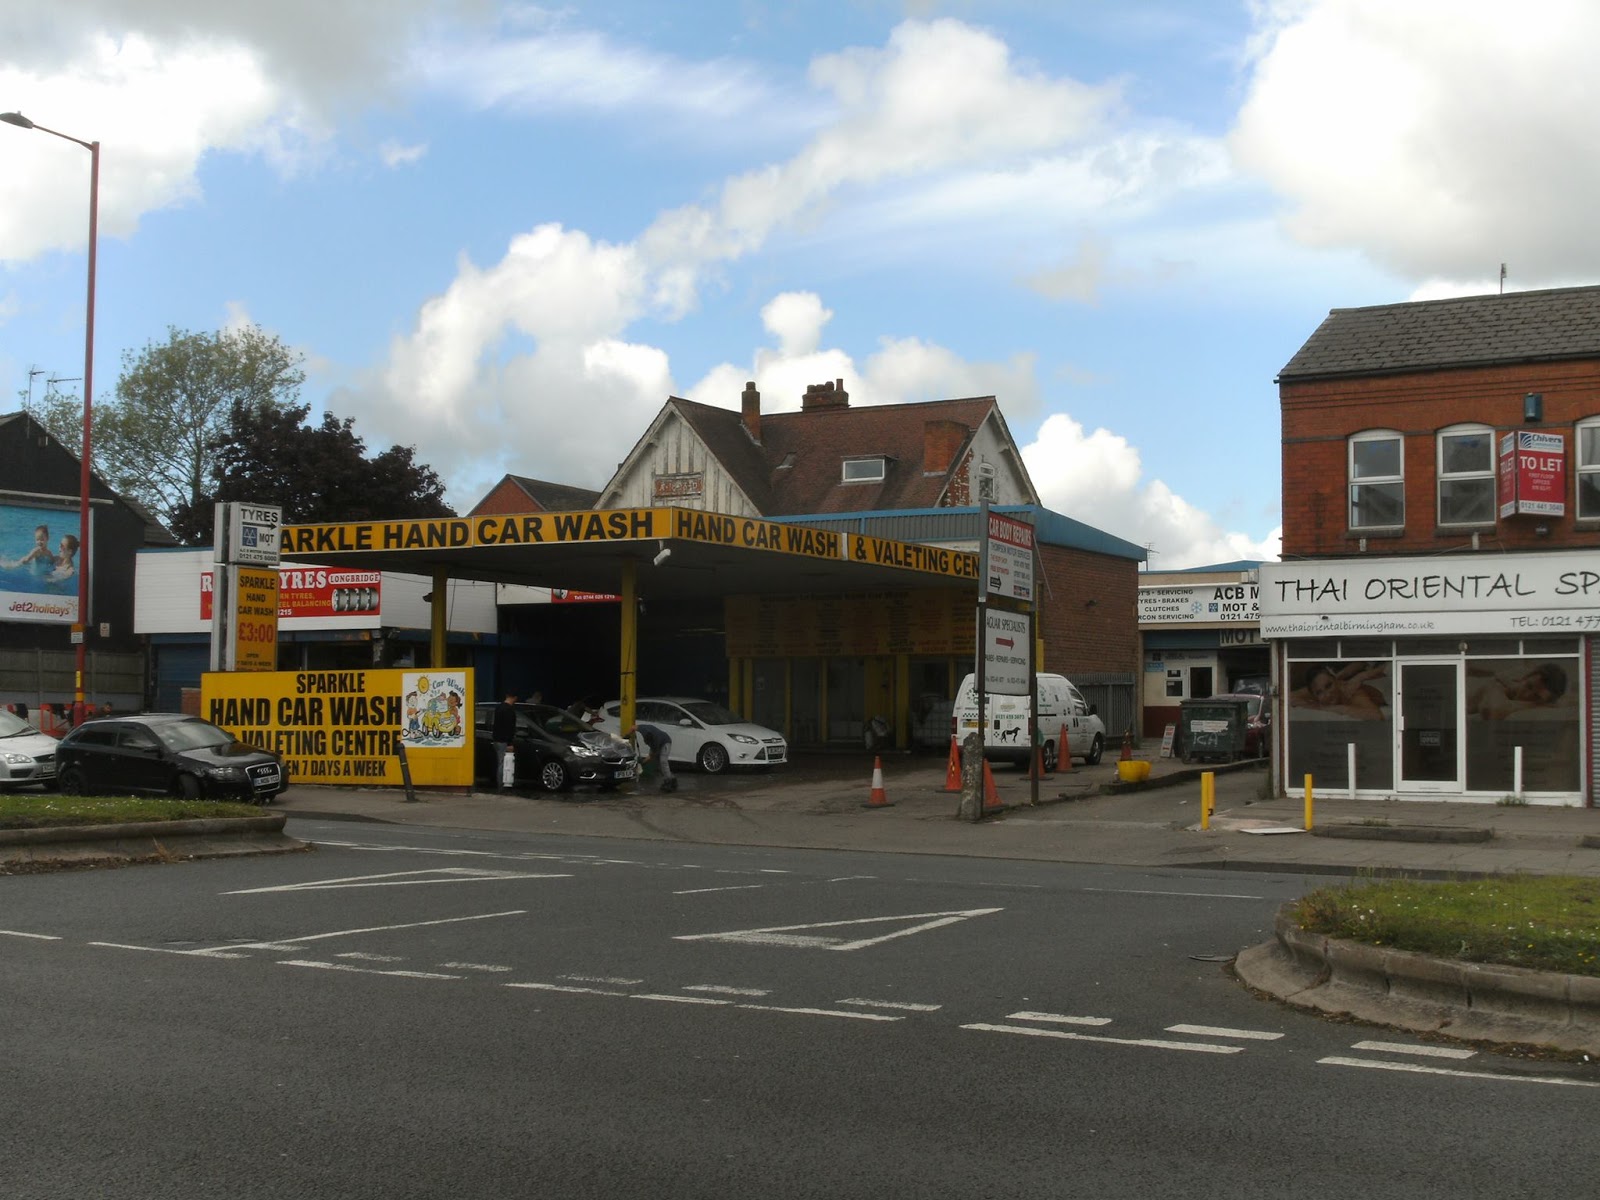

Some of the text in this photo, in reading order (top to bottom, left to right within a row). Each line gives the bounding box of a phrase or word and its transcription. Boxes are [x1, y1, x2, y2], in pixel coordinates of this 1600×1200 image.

[1520, 456, 1562, 472] TO LET
[241, 508, 279, 523] TYRES
[259, 533, 275, 545] MOT
[280, 512, 654, 552] ARKLE HAND CAR WASH
[989, 517, 1032, 547] CAR BODY REPAIRS
[678, 511, 980, 578] HAND CAR WASH & VALETING CEN
[239, 576, 276, 590] SPARKLE
[279, 571, 327, 589] YRES
[331, 573, 379, 583] LONGBRIDGE
[1274, 571, 1600, 603] THAI ORIENTAL SP
[246, 593, 266, 602] HAND
[1214, 587, 1245, 600] ACB
[9, 602, 70, 617] jet2holidays
[238, 606, 274, 616] CAR WASH
[292, 600, 331, 608] BALANCING
[1222, 603, 1260, 612] MOT &
[1002, 618, 1026, 634] SPECIALISTS
[1265, 621, 1435, 633] www.thaiorientalbirmingham.co.uk
[1510, 616, 1539, 627] TEL:
[1542, 616, 1571, 626] 0121
[1221, 630, 1255, 644] MOT
[296, 672, 365, 694] SPARKLE
[432, 680, 445, 689] Car
[210, 696, 402, 728] HAND CAR WASH
[242, 730, 401, 757] VALETING CENTRE
[287, 759, 386, 776] EN 7 DAYS A WEEK
